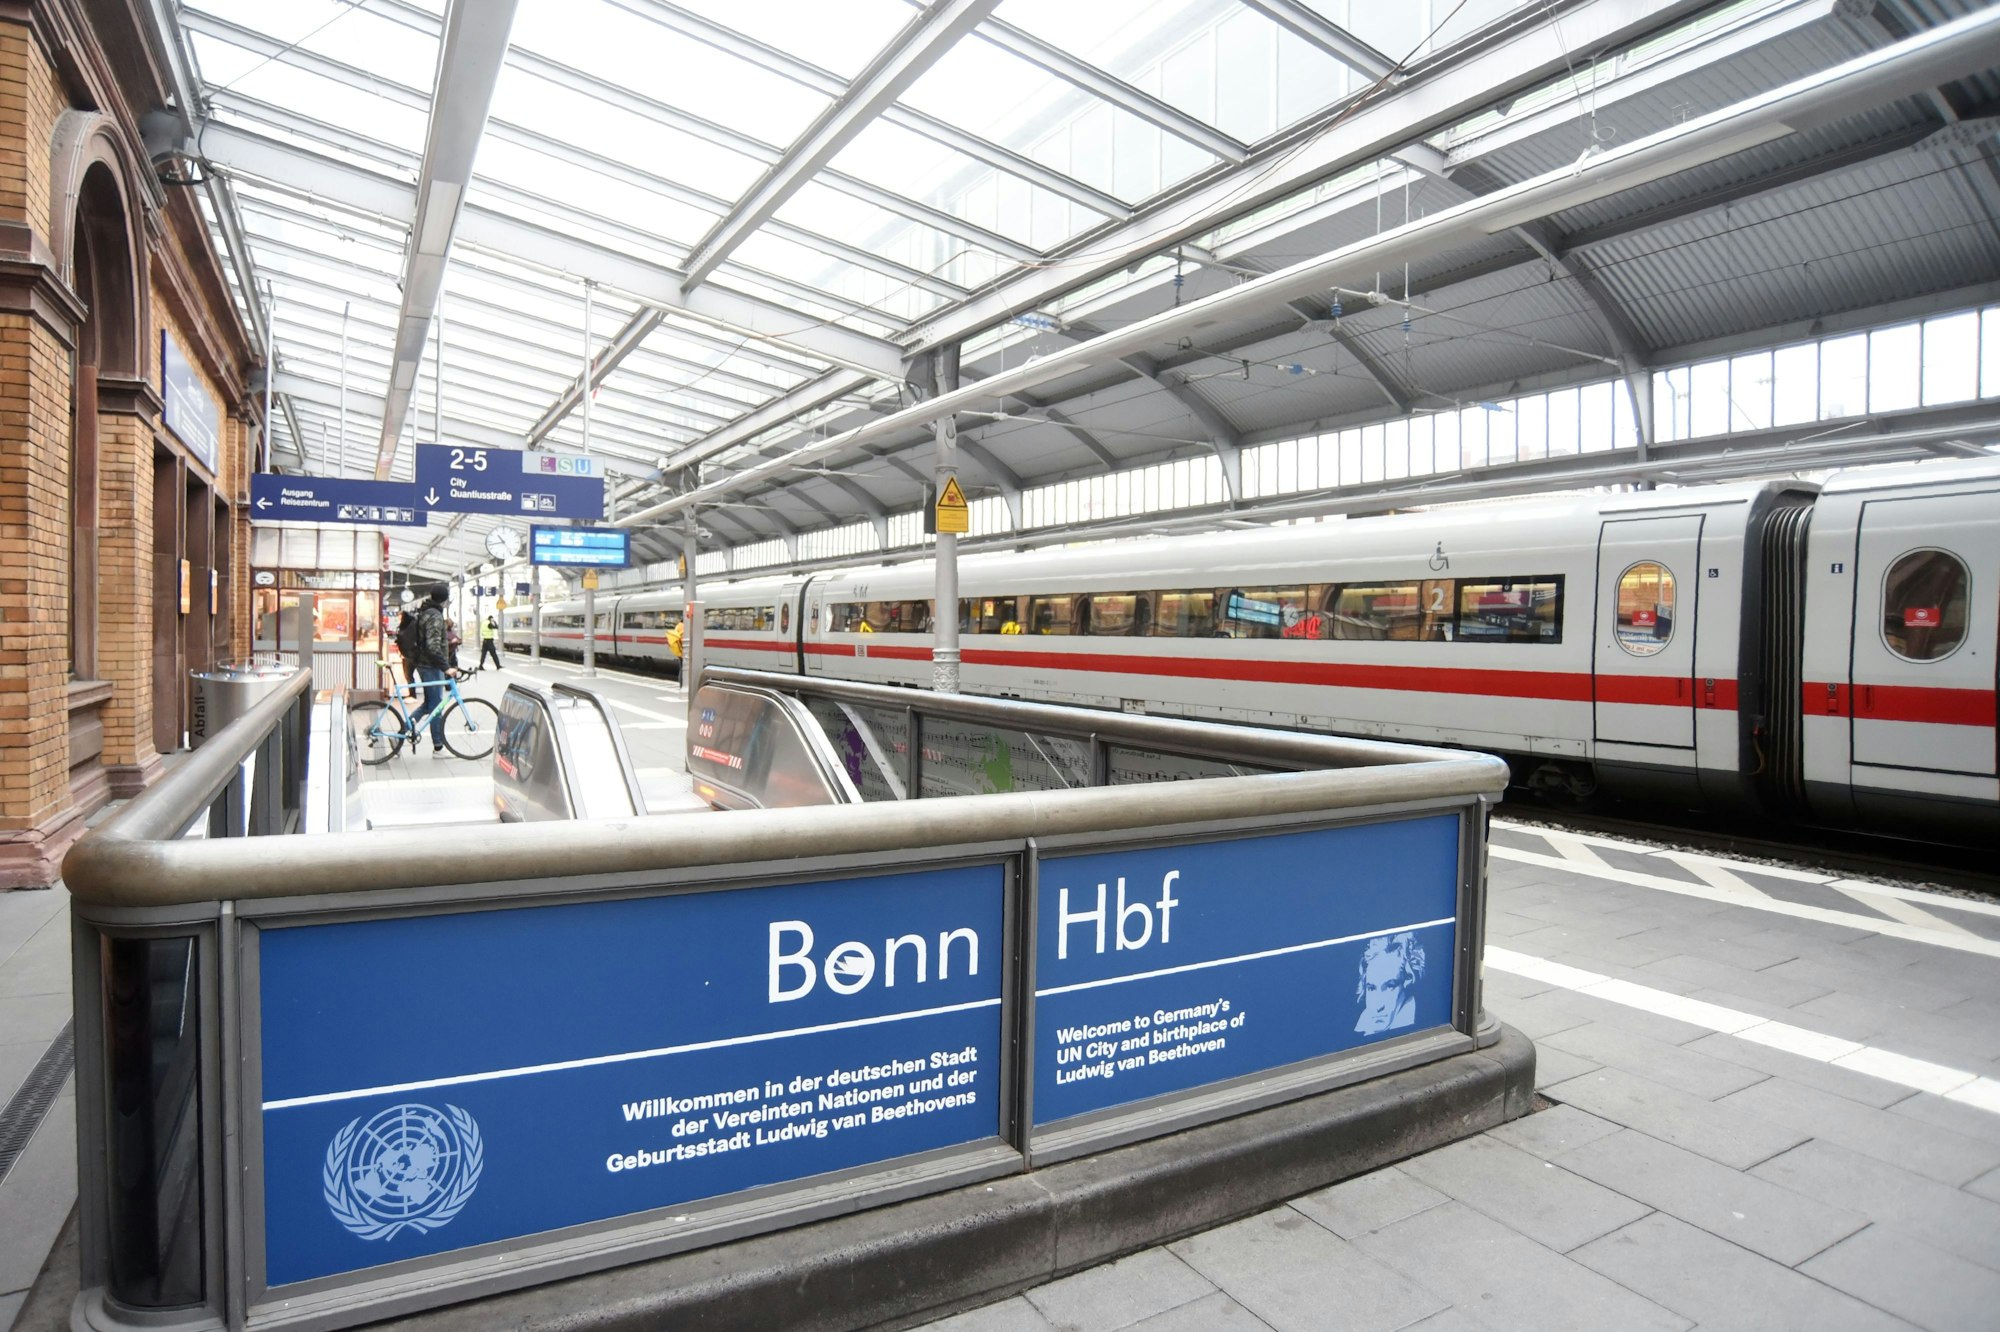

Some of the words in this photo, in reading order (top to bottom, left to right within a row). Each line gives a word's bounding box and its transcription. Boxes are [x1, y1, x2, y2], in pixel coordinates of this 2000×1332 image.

[450, 448, 488, 471] 2-5
[577, 459, 590, 473] U
[280, 497, 330, 508] Reisezentrum
[281, 487, 314, 499] Ausgang
[450, 477, 467, 488] City
[450, 488, 512, 501] Quantiusstraße
[1431, 587, 1444, 611] 2
[194, 696, 206, 738] Abfall
[769, 919, 979, 1003] Bonn
[1058, 870, 1180, 960] Hbf
[1056, 1020, 1132, 1045] Welcome
[1133, 1015, 1151, 1030] to
[1153, 997, 1230, 1025] Germany’s
[1056, 1045, 1083, 1065] UN
[1085, 1041, 1119, 1059] City
[1120, 1031, 1150, 1052] and
[1153, 1019, 1228, 1045] birthplace
[1230, 1011, 1246, 1028] of
[1056, 1060, 1115, 1085] Ludwig
[1117, 1055, 1145, 1071] van
[1148, 1037, 1226, 1065] Beethoven
[622, 1087, 760, 1122] Willkommen
[765, 1080, 784, 1098] in
[788, 1076, 823, 1094] der
[826, 1058, 926, 1088] deutschen
[929, 1046, 978, 1069] Stadt
[671, 1118, 709, 1138] der
[712, 1099, 813, 1130] Vereinten
[818, 1083, 905, 1111] Nationen
[908, 1073, 943, 1095] und
[946, 1070, 978, 1087] der
[606, 1131, 751, 1173] Geburtsstadt
[755, 1117, 829, 1146] Ludwig
[831, 1112, 866, 1131] van
[871, 1091, 976, 1124] Beethovens
